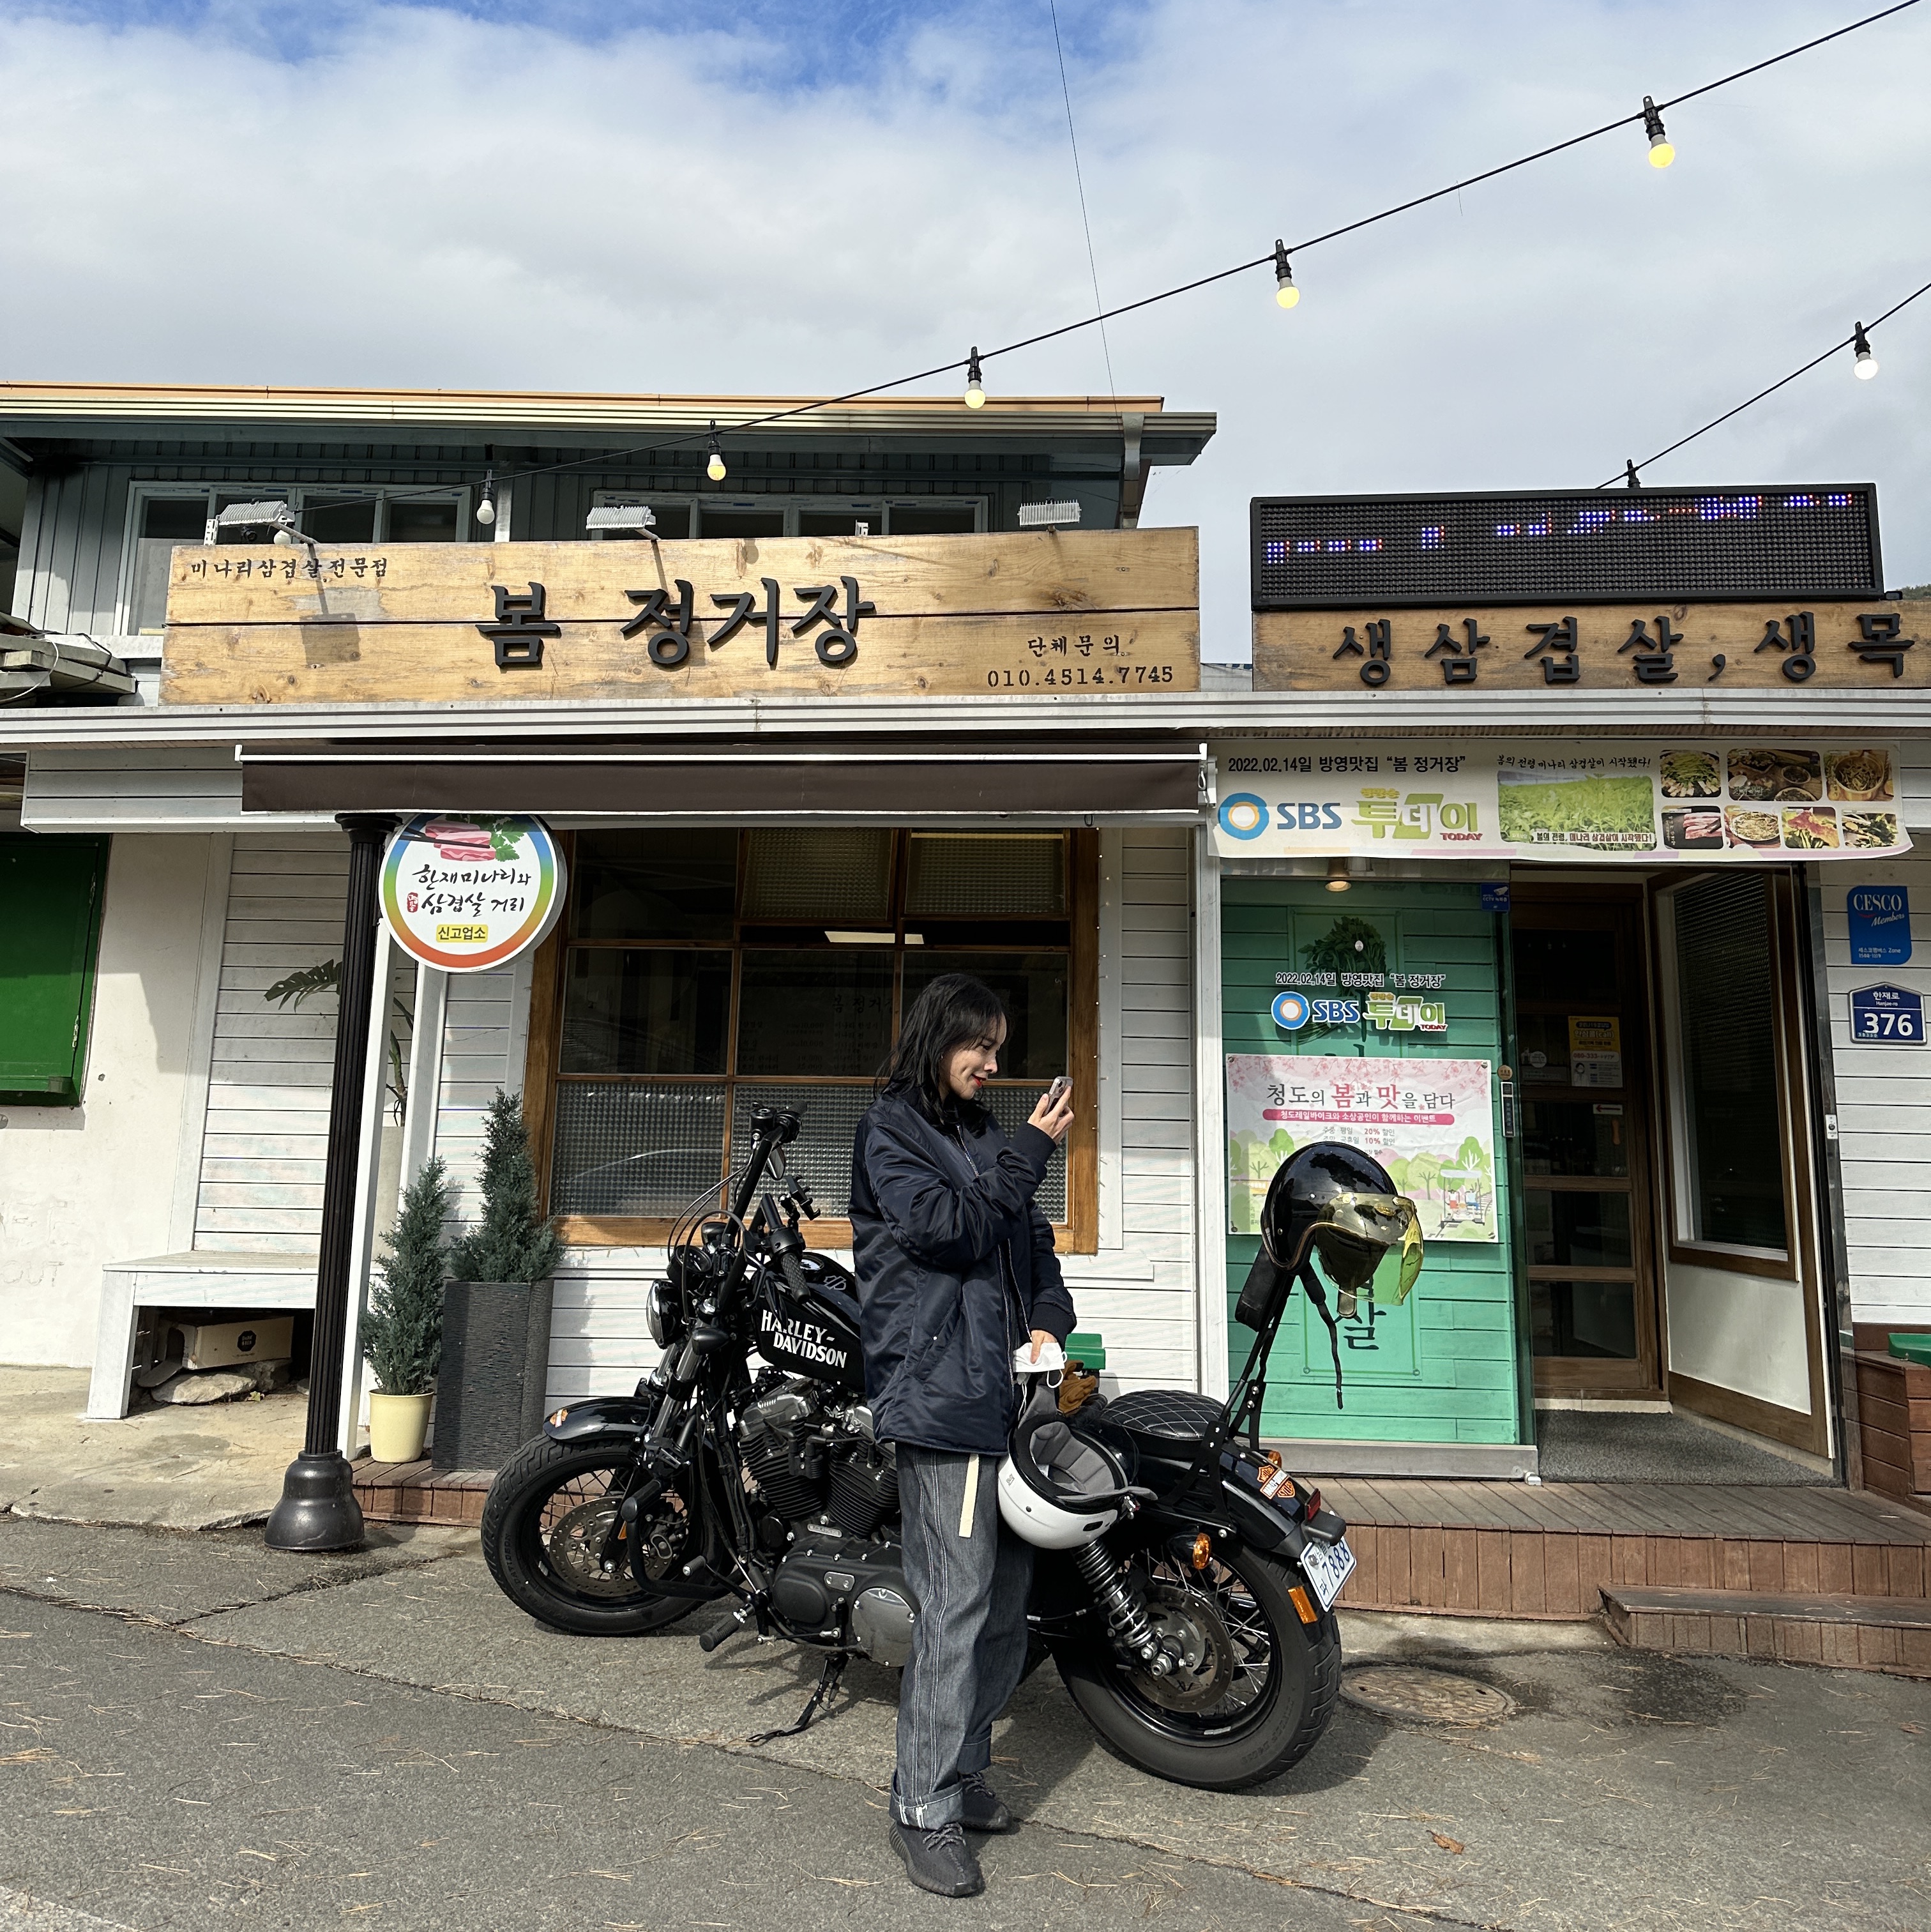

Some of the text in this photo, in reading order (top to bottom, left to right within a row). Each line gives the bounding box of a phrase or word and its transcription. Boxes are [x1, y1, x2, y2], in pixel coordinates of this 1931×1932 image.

[476, 575, 874, 669] 봄 정거장
[987, 665, 1174, 689] 010.4514.7745
[1229, 756, 1312, 773] 2022.02.14일
[1319, 756, 1379, 773] 방영맛집
[1497, 754, 1515, 766] 봄의
[1518, 757, 1536, 769] 전령
[1538, 759, 1566, 770] 미나리
[1569, 757, 1605, 770] 삼겹살이
[1276, 802, 1342, 830] SBS
[1351, 793, 1479, 840] 투데이
[1440, 832, 1483, 841] TODAY
[1569, 833, 1590, 842] 미나리
[412, 863, 531, 890] 한재미나리와
[421, 892, 486, 918] 삼겹살
[491, 897, 525, 913] 거리
[1854, 894, 1902, 911] CESCO
[1871, 913, 1905, 927] Members
[437, 926, 486, 941] 신고업소
[1276, 971, 1336, 985] 2022.02.14일
[1342, 973, 1384, 987] 방영맛집
[1873, 991, 1900, 1000] 한재로
[1312, 1000, 1359, 1023] SBS
[1864, 1012, 1913, 1037] 376
[1266, 1083, 1455, 1110] 청도의 봄과 맛을 담다
[1281, 1111, 1436, 1123] 청도레일바이크와 소상공인이 함께하는 이벤트
[761, 1309, 835, 1344] HARLEY-
[773, 1332, 847, 1369] DAVIDSON
[1321, 1540, 1350, 1588] 7888
